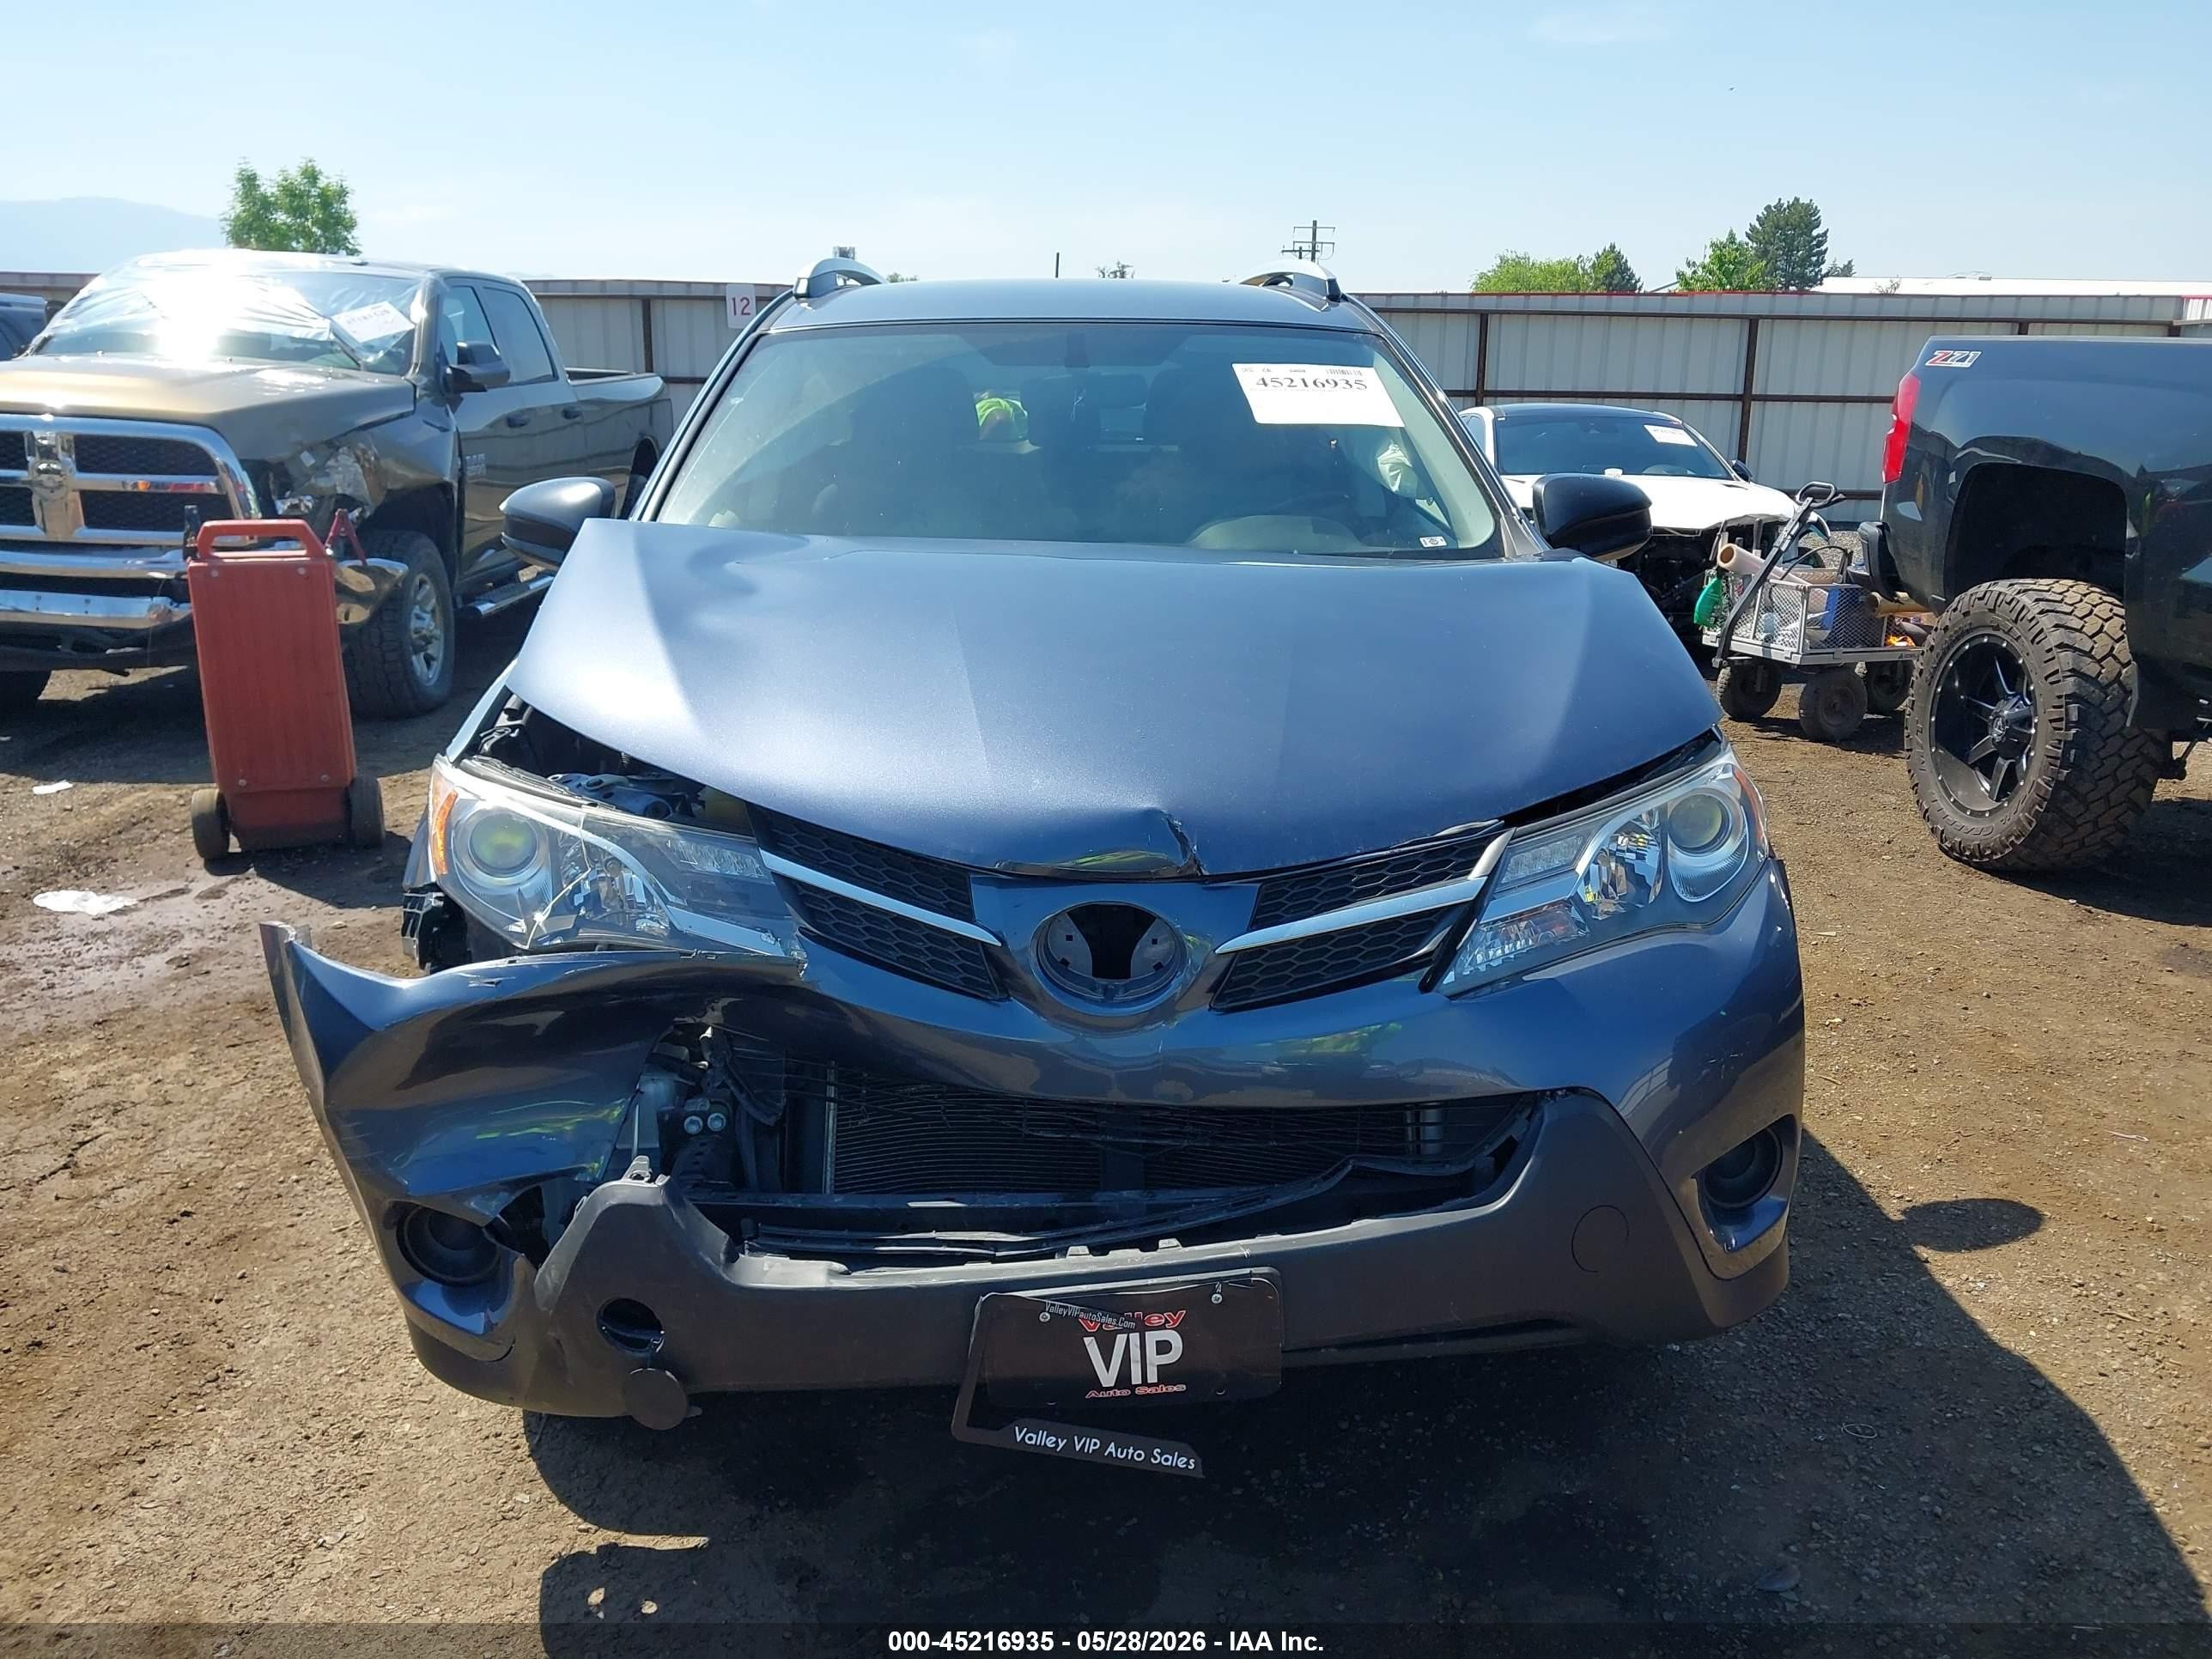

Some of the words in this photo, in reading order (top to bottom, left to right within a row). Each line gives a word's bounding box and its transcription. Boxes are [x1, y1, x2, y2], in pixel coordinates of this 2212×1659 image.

[732, 296, 751, 316] 12
[1924, 349, 1983, 368] Z71
[1255, 376, 1369, 392] 45216935
[1045, 1301, 1137, 1330] ValleyVIPautoSales.Com
[1083, 1328, 1184, 1388] VIP
[1085, 1388, 1132, 1399] Auto
[1134, 1383, 1188, 1395] Sales
[1014, 1425, 1067, 1452] Valley
[1073, 1435, 1101, 1454] VIP
[1103, 1442, 1146, 1462] Auto
[1151, 1448, 1196, 1470] Sales
